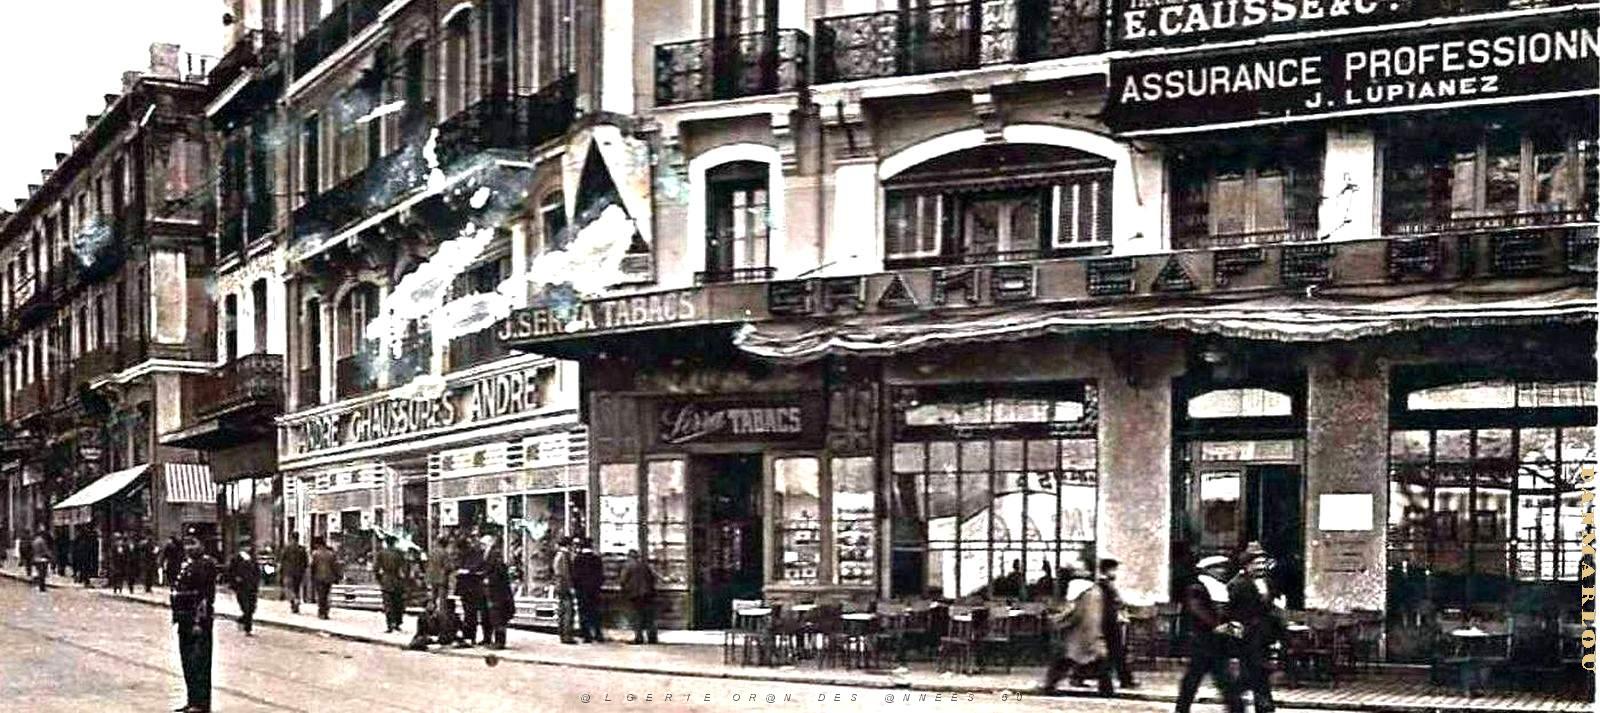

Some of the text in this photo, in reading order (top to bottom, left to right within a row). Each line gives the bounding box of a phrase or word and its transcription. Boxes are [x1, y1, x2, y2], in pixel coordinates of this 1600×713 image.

[1121, 56, 1322, 104] ASSURANCE
[1305, 75, 1499, 109] J. LUPIANEZ
[498, 291, 696, 341] J.SERA TABACS
[469, 368, 538, 422] ANDRE
[727, 407, 802, 434] TABACS
